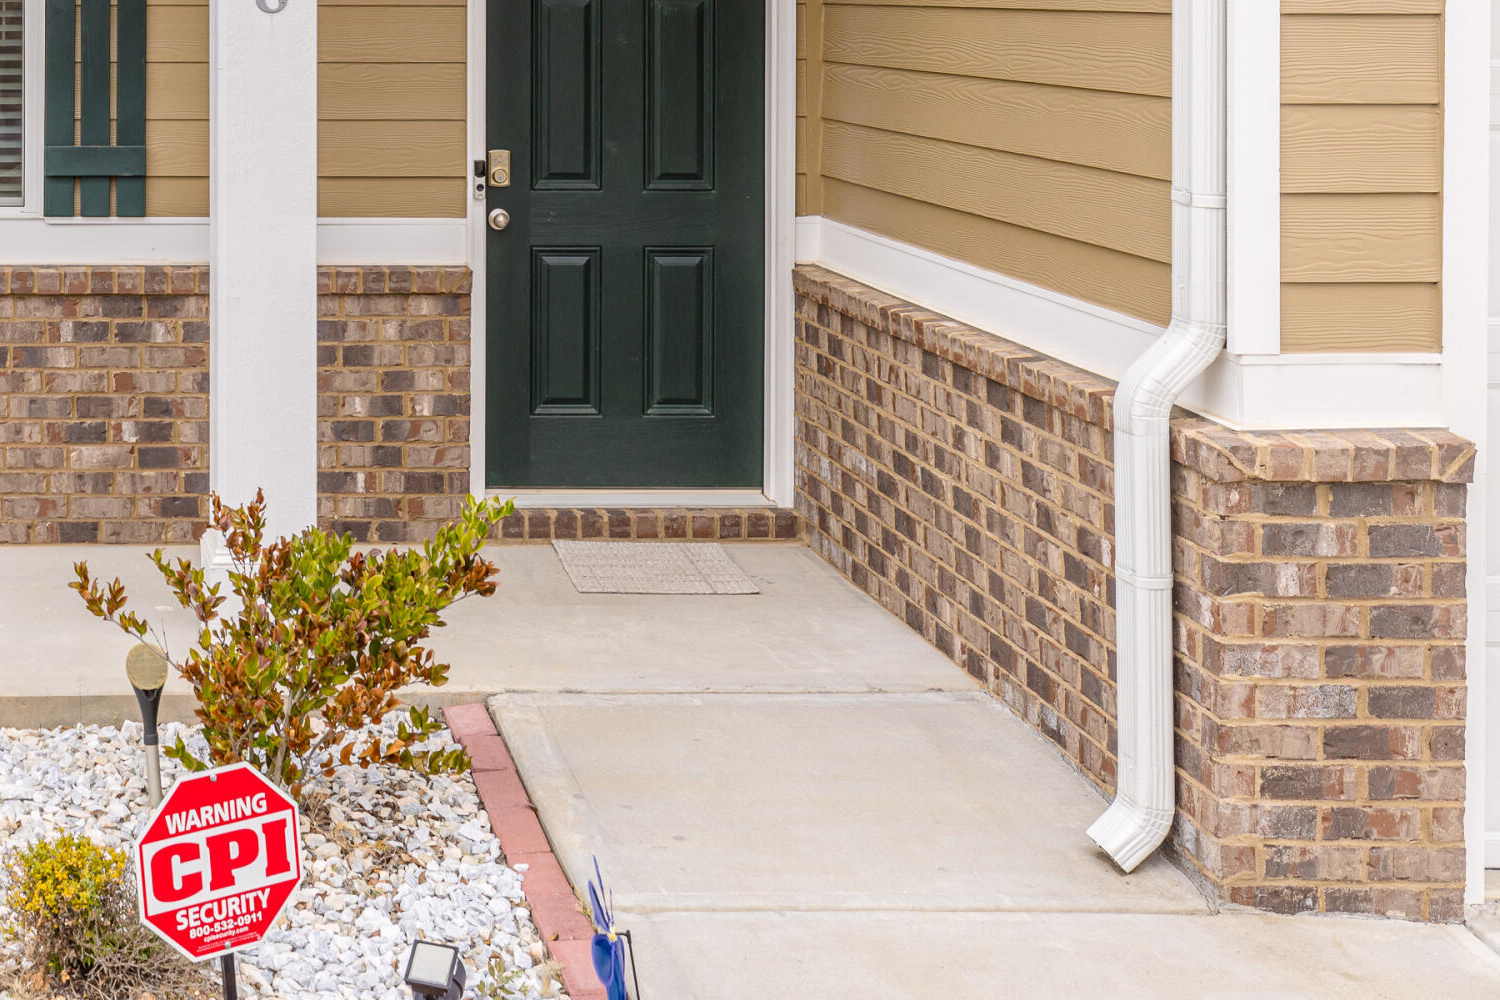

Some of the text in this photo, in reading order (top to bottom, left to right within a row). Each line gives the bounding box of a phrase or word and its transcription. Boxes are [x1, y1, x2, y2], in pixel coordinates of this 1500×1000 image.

[165, 792, 267, 835] WARNING
[150, 818, 291, 903] CPI
[176, 888, 270, 931] SECURITY
[189, 911, 262, 939] 800-532-0911
